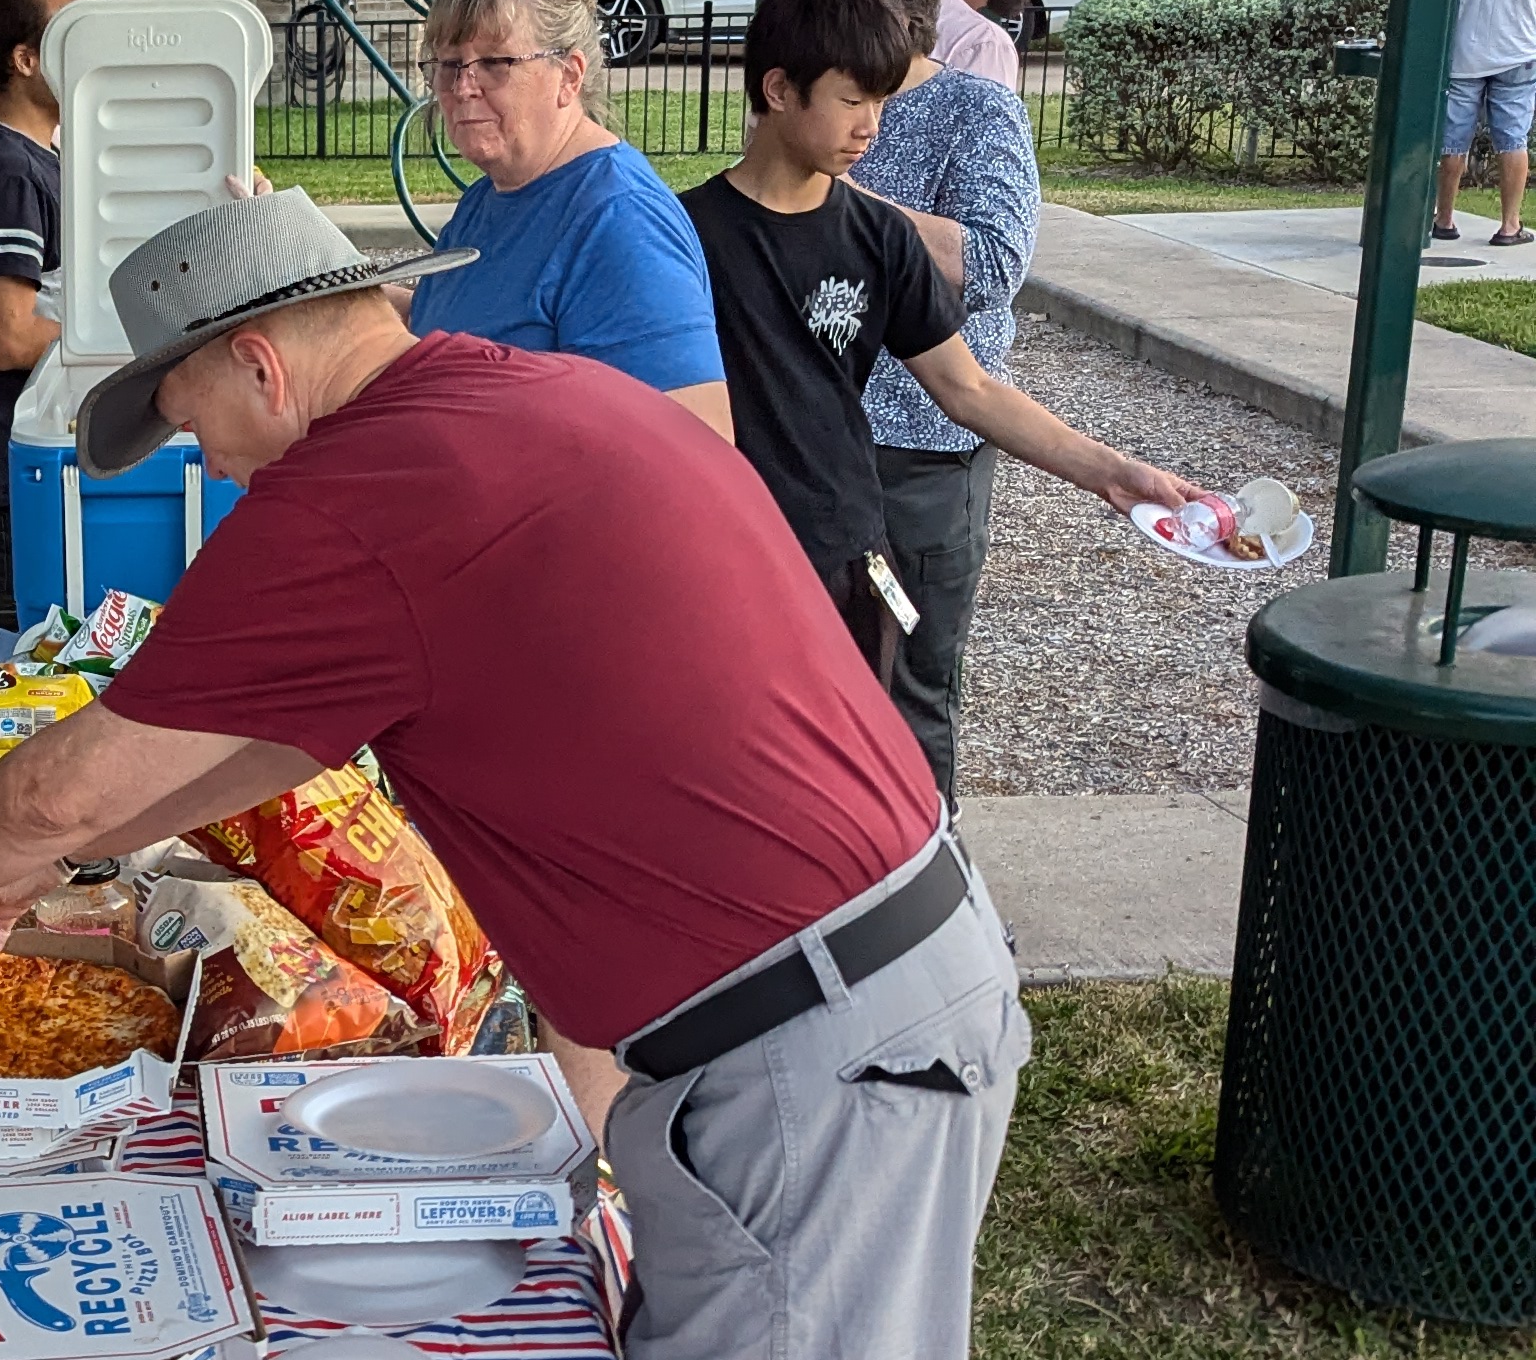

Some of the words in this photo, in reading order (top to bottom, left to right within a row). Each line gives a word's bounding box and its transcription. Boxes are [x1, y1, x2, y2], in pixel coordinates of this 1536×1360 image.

[127, 25, 182, 53] igloo
[85, 590, 128, 658] Veggie
[154, 915, 175, 937] USDA
[159, 1205, 179, 1246] CARRYOUT
[281, 1211, 314, 1222] ALIGN
[317, 1211, 351, 1221] LABEL
[353, 1210, 382, 1220] HERE
[117, 1233, 154, 1256] BOX
[61, 1201, 131, 1336] RECYCLE
[121, 1253, 135, 1276] THIS
[129, 1259, 159, 1295] PIZZA
[170, 1248, 190, 1288] DOMINO'S
